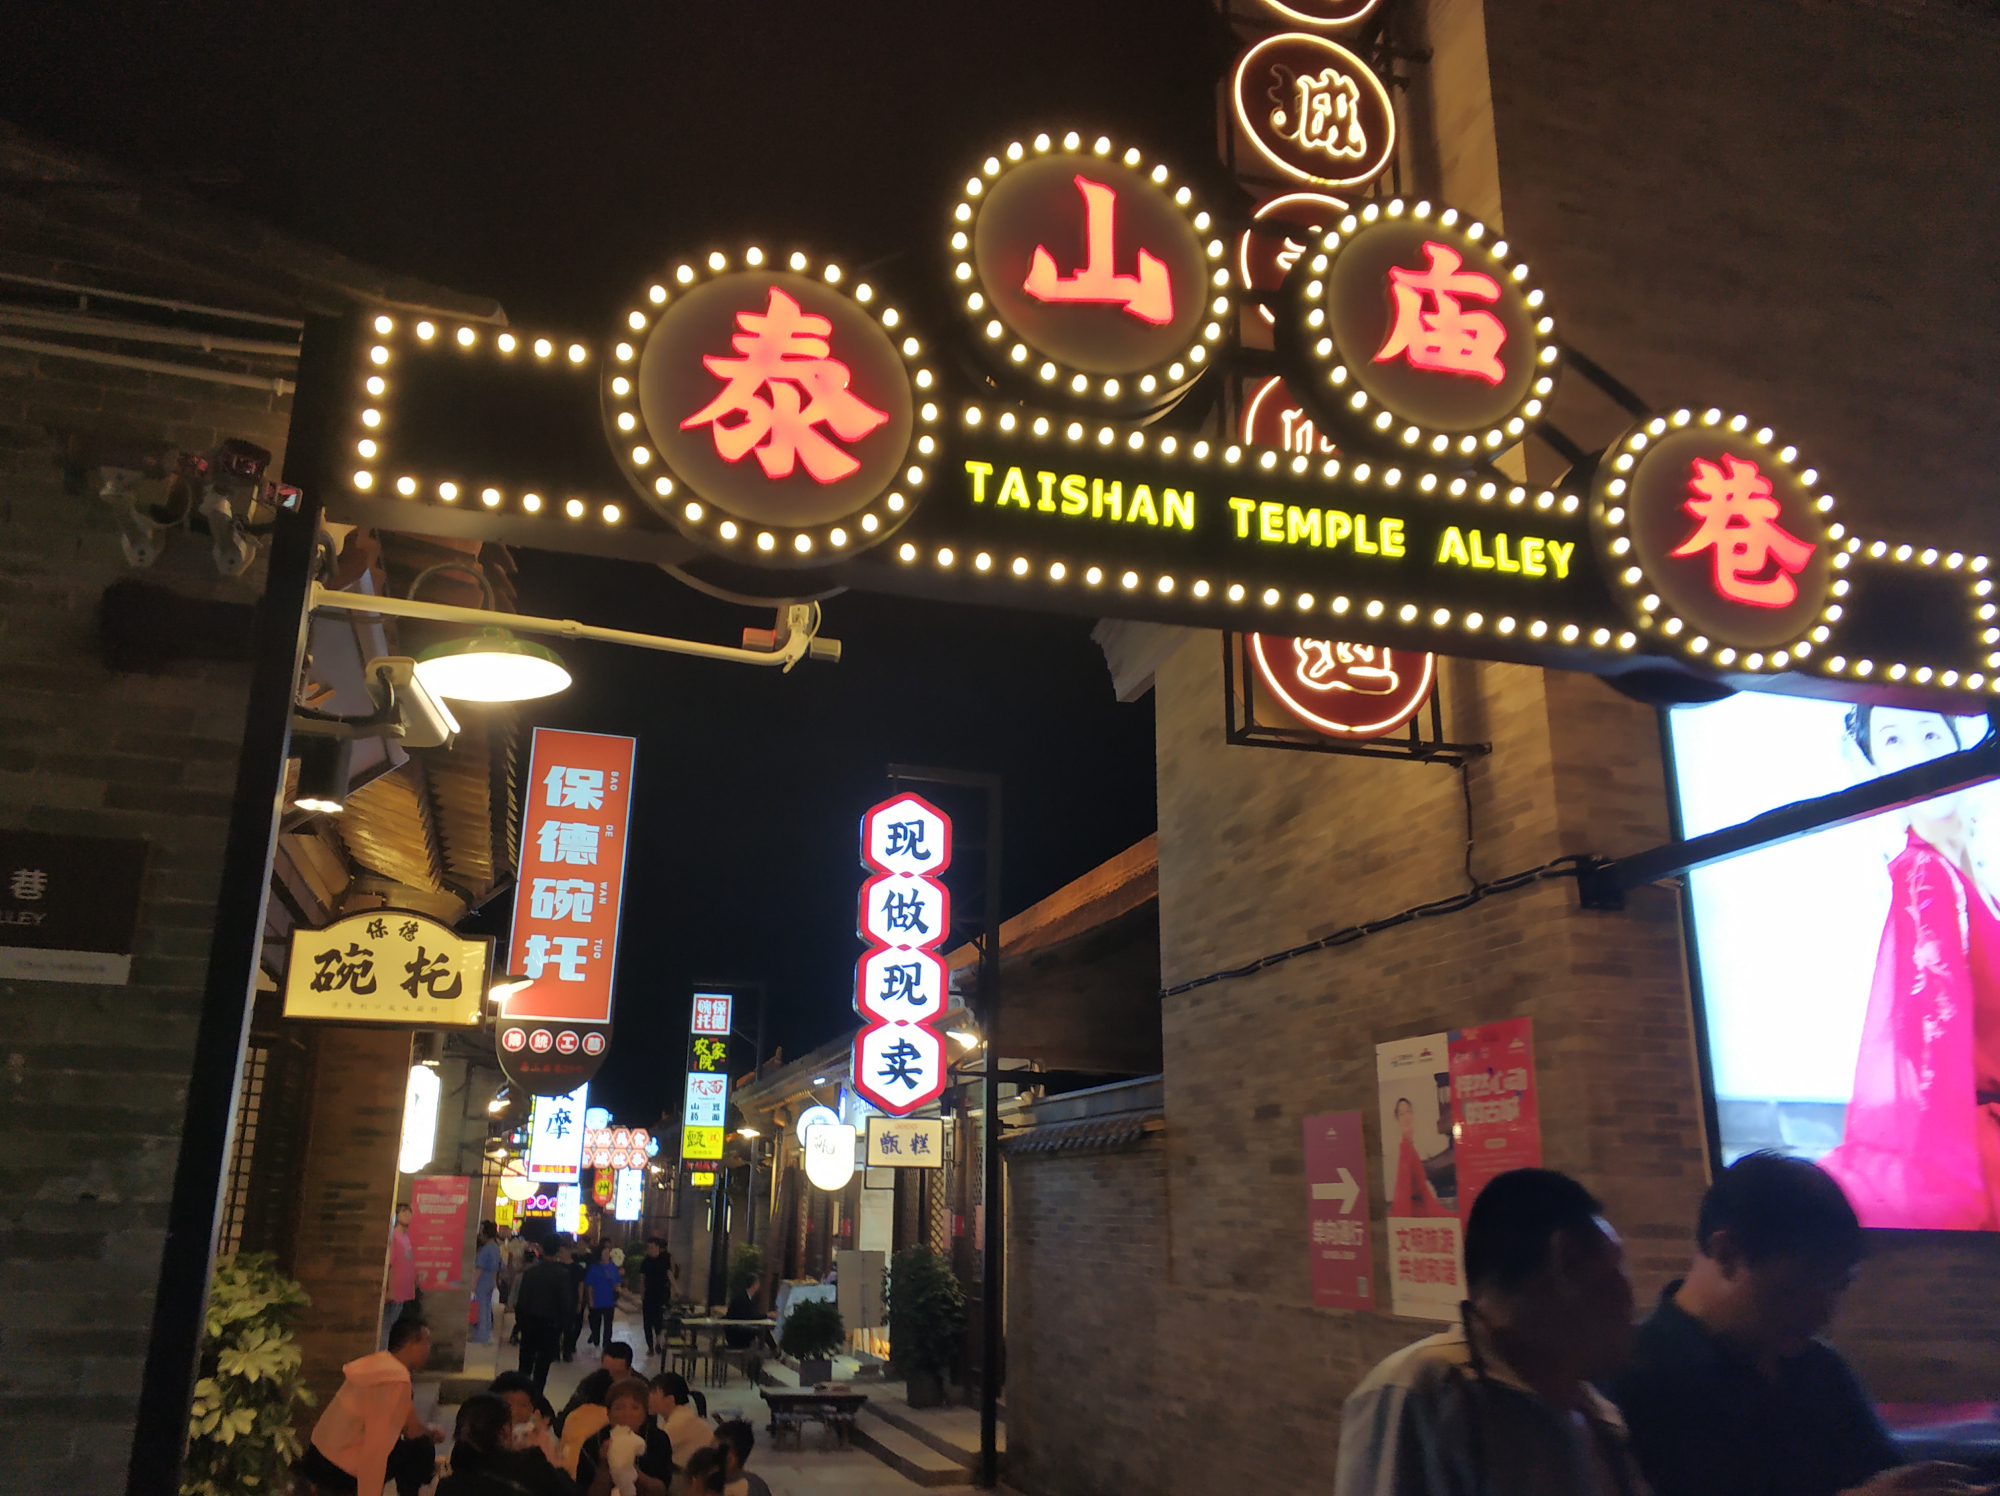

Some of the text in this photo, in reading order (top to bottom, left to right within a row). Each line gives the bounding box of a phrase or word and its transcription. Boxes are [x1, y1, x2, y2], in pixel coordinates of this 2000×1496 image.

[965, 460, 1577, 580] TAISHAN TEMPLE ALLEY
[366, 917, 420, 942] 保德
[523, 765, 605, 983] 保德碗托
[593, 770, 619, 959] BAO DE WAN TUO
[310, 943, 463, 1000] 碗托
[877, 820, 931, 1090] 现做现卖
